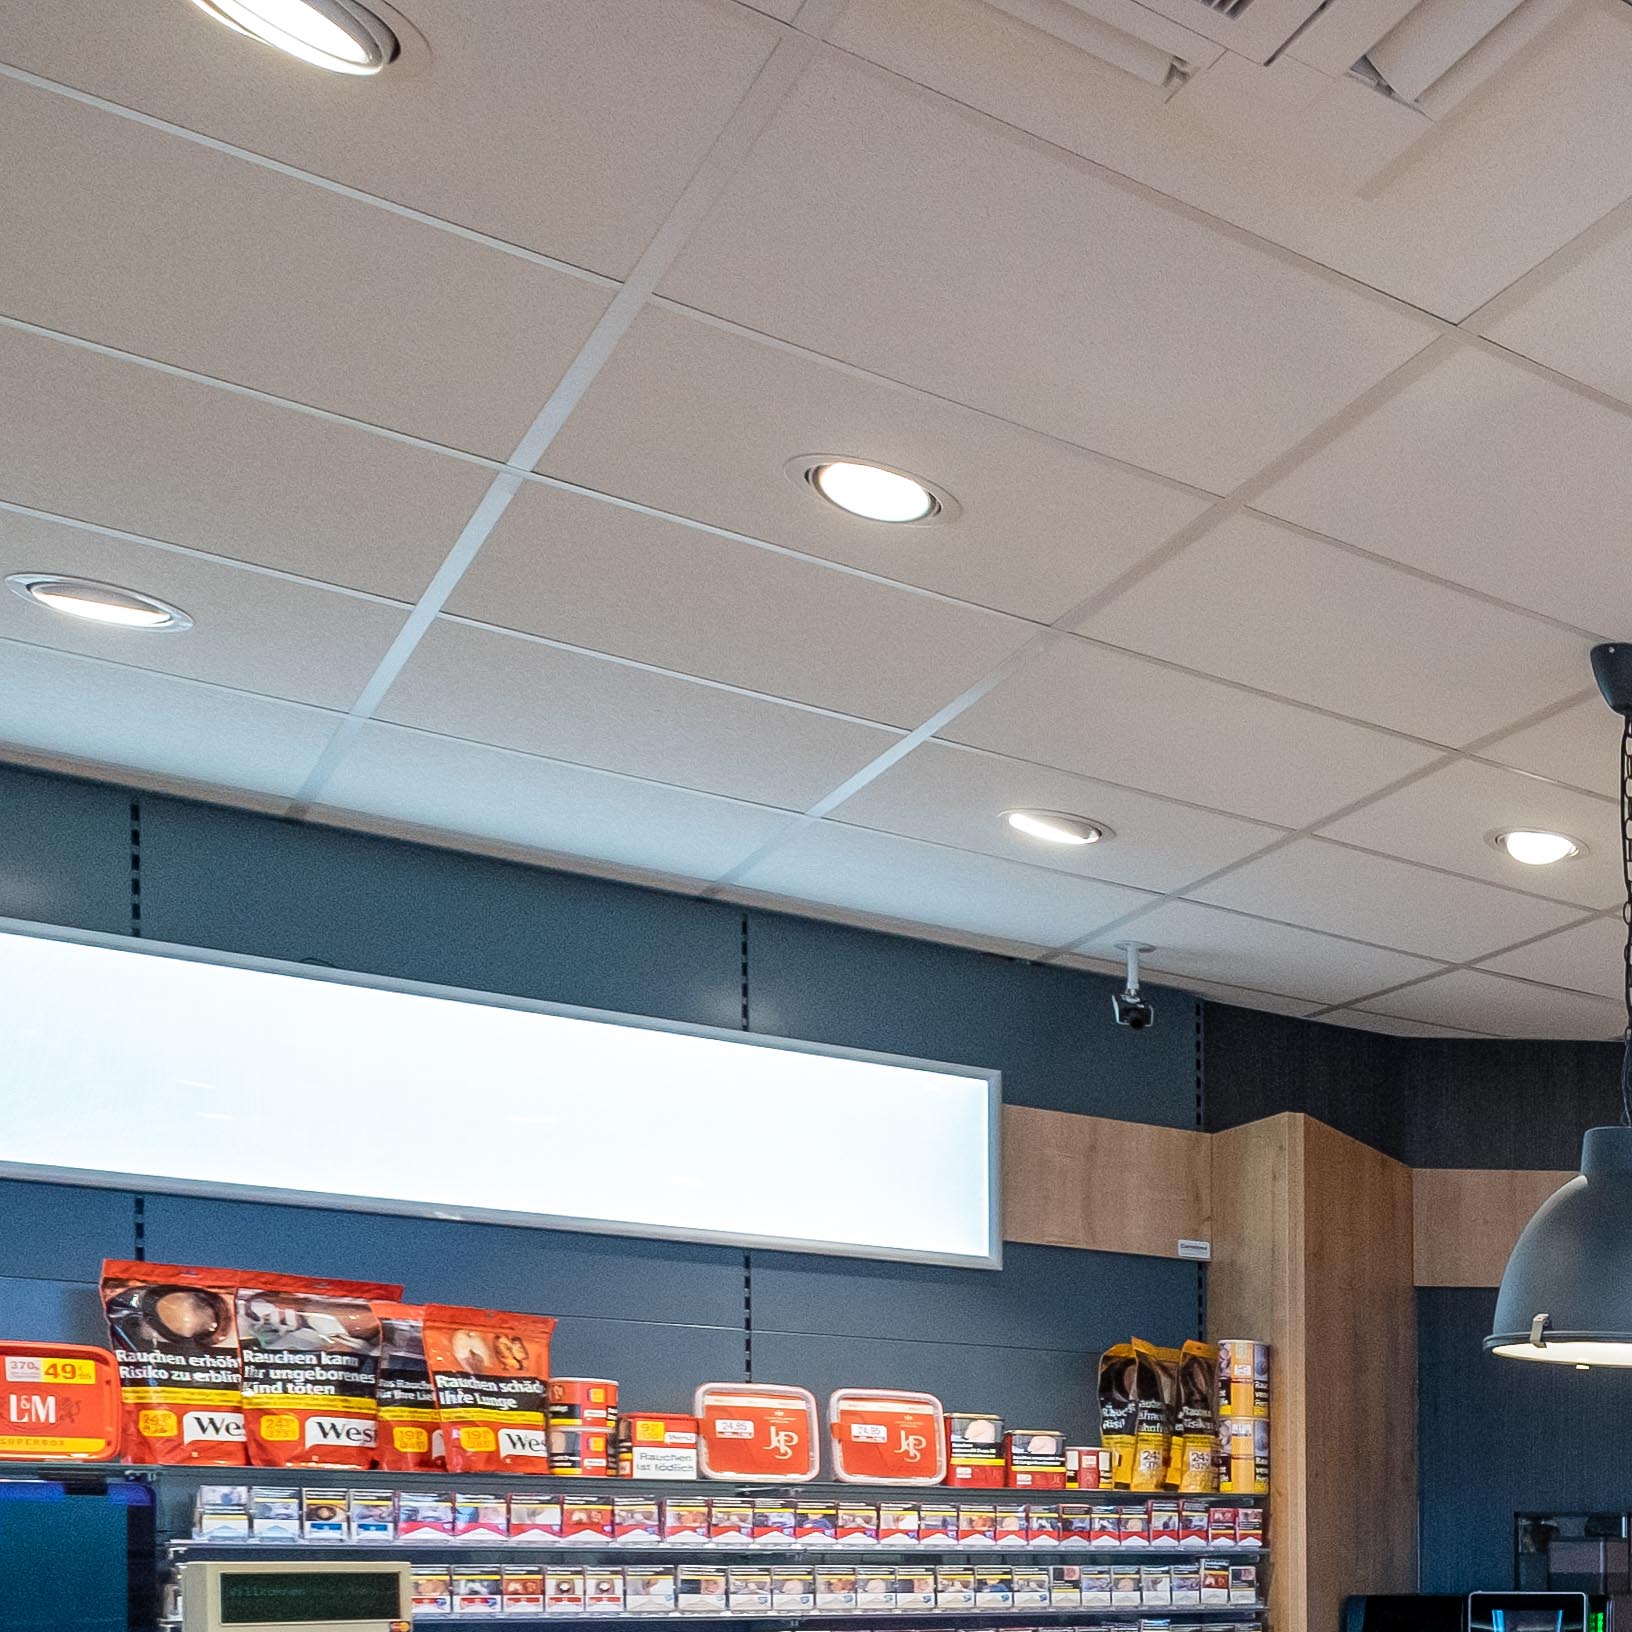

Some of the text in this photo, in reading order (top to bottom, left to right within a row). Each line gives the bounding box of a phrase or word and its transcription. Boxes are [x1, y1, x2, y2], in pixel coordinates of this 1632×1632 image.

[116, 1350, 240, 1368] Rauchen erhöh
[243, 1350, 317, 1364] Rauchen
[120, 1366, 168, 1380] Risiko
[172, 1371, 192, 1381] zu
[245, 1367, 376, 1384] Ihr ungeborenes
[287, 1382, 335, 1395] töten
[435, 1375, 498, 1392] Rauchen
[439, 1389, 518, 1411] Ihre Lunge
[10, 1394, 56, 1424] L&M
[195, 1417, 246, 1436] We
[639, 1451, 692, 1462] Rauchen
[636, 1462, 694, 1474] ist tödlich
